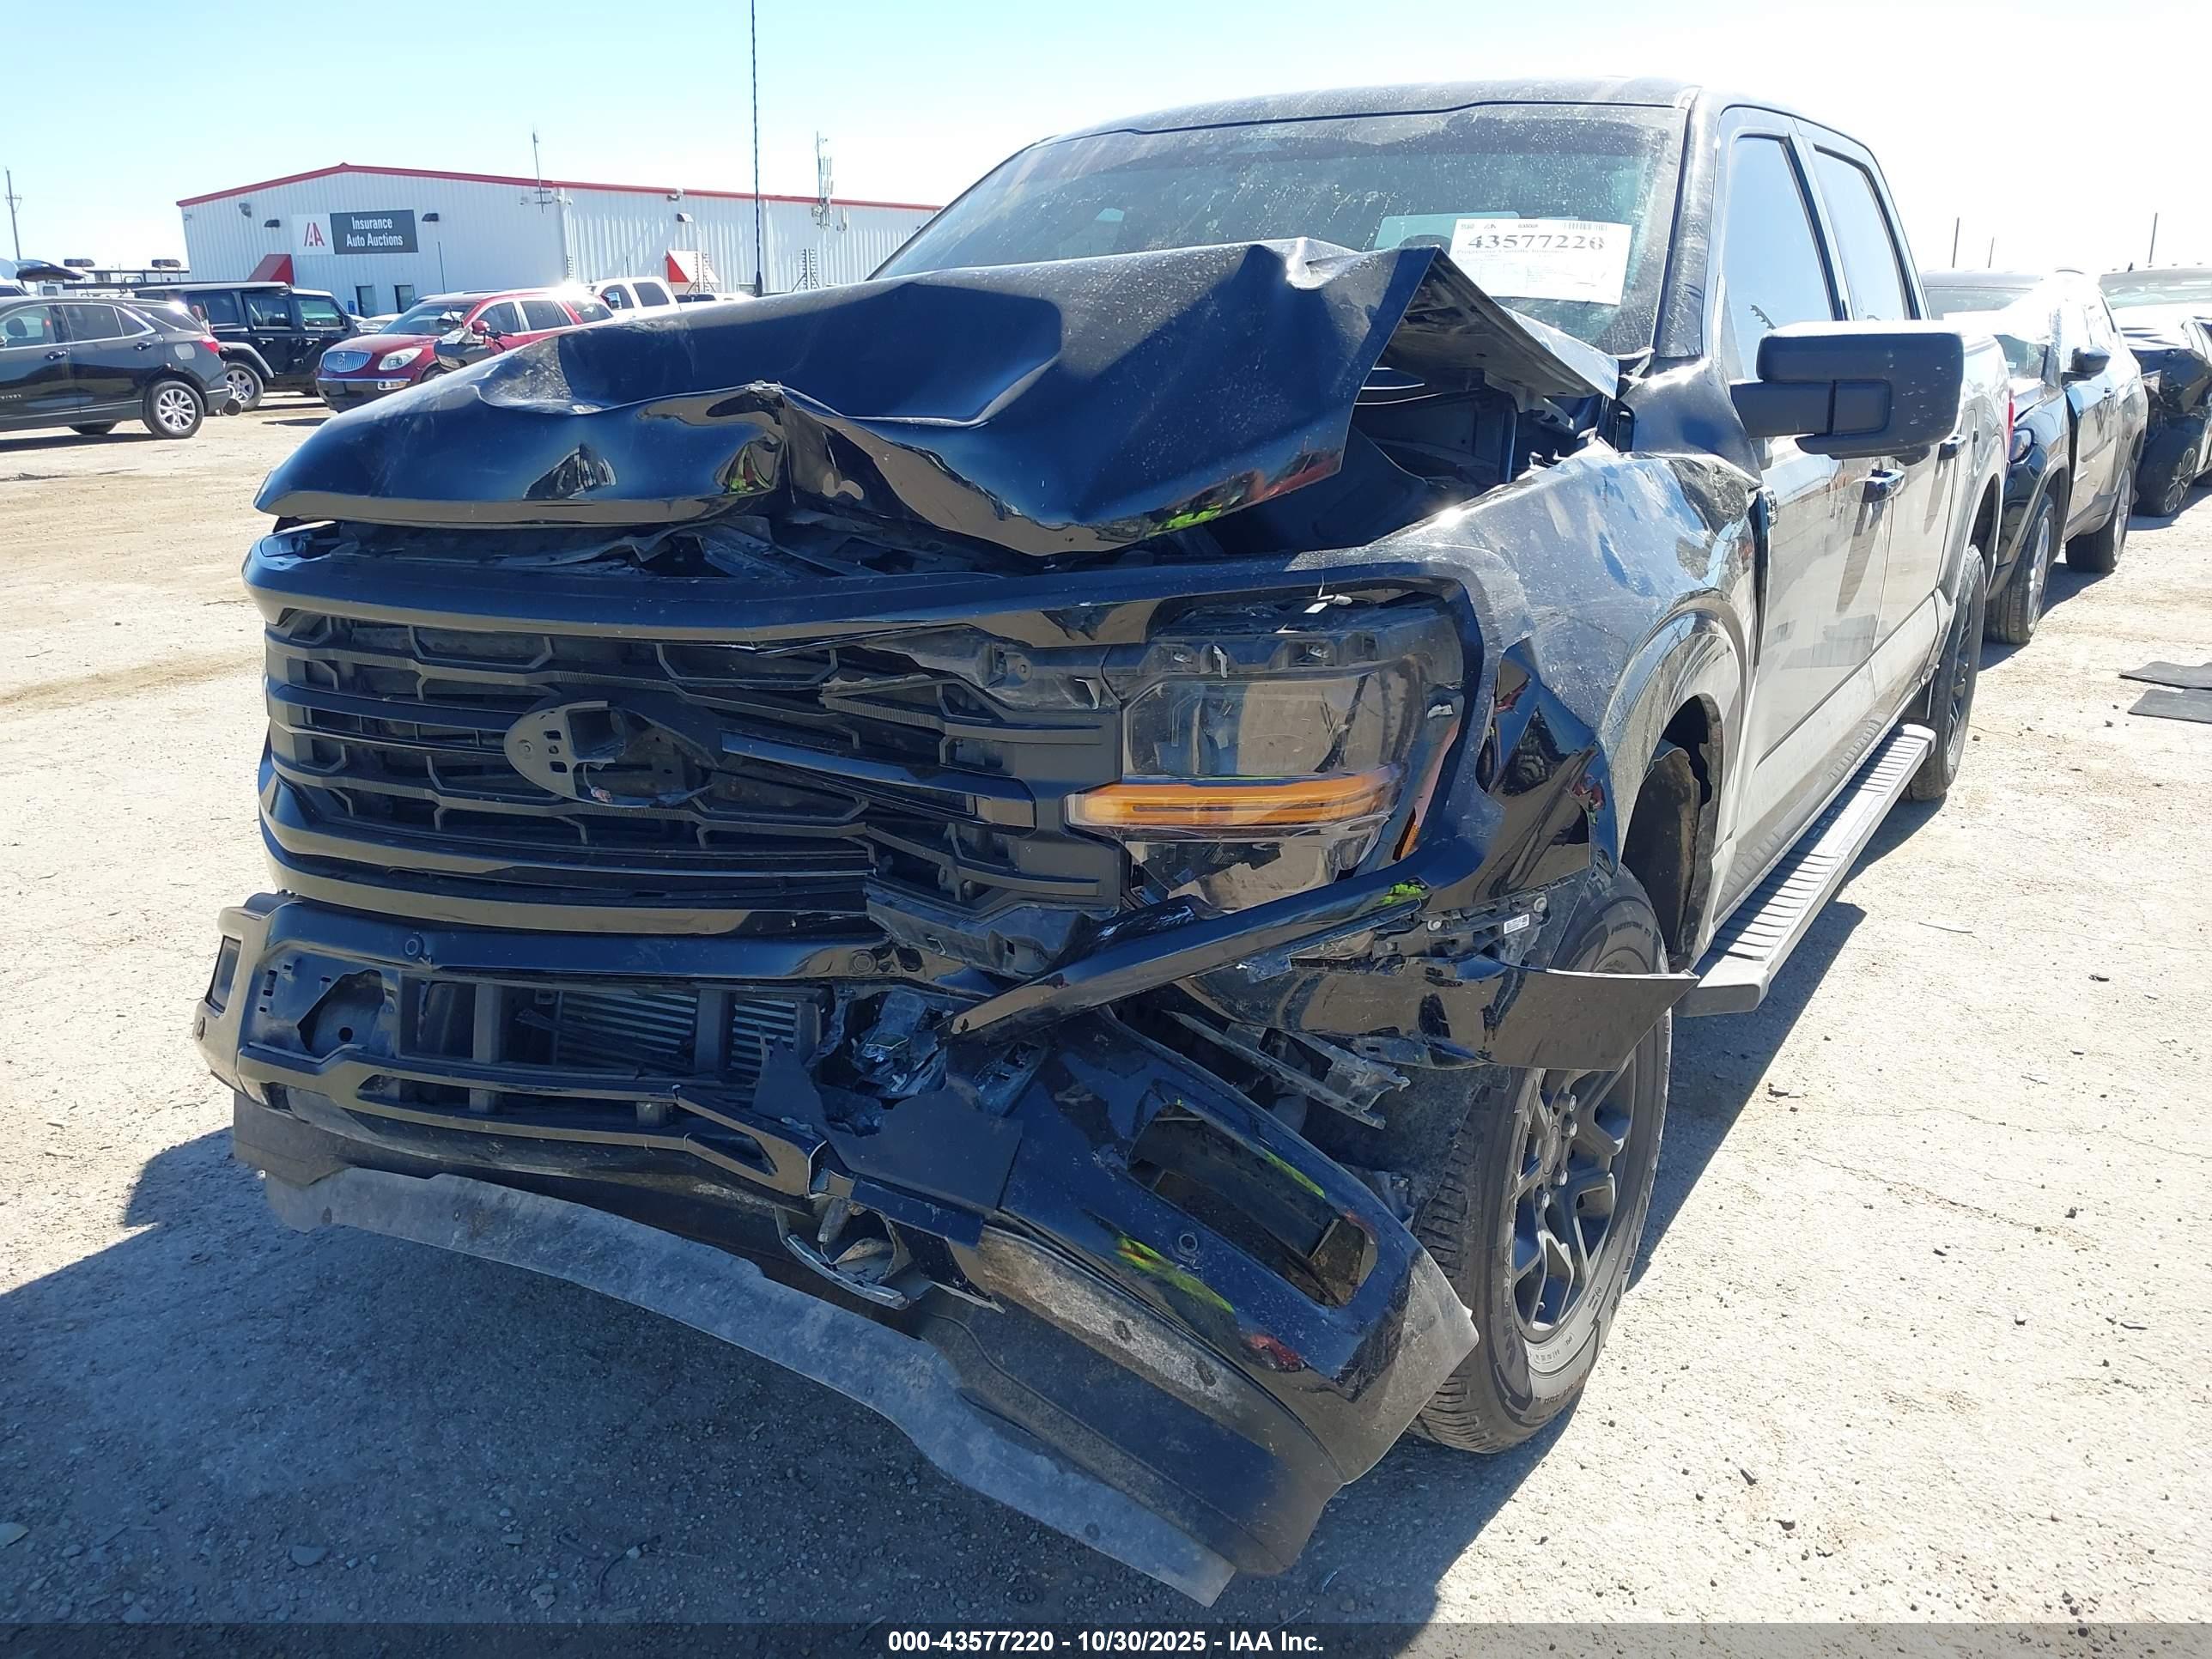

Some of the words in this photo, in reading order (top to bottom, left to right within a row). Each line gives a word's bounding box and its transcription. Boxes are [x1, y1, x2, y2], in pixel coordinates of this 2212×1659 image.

[351, 216, 393, 230] Insurance
[346, 233, 366, 247] Auto
[367, 232, 404, 246] Auctions
